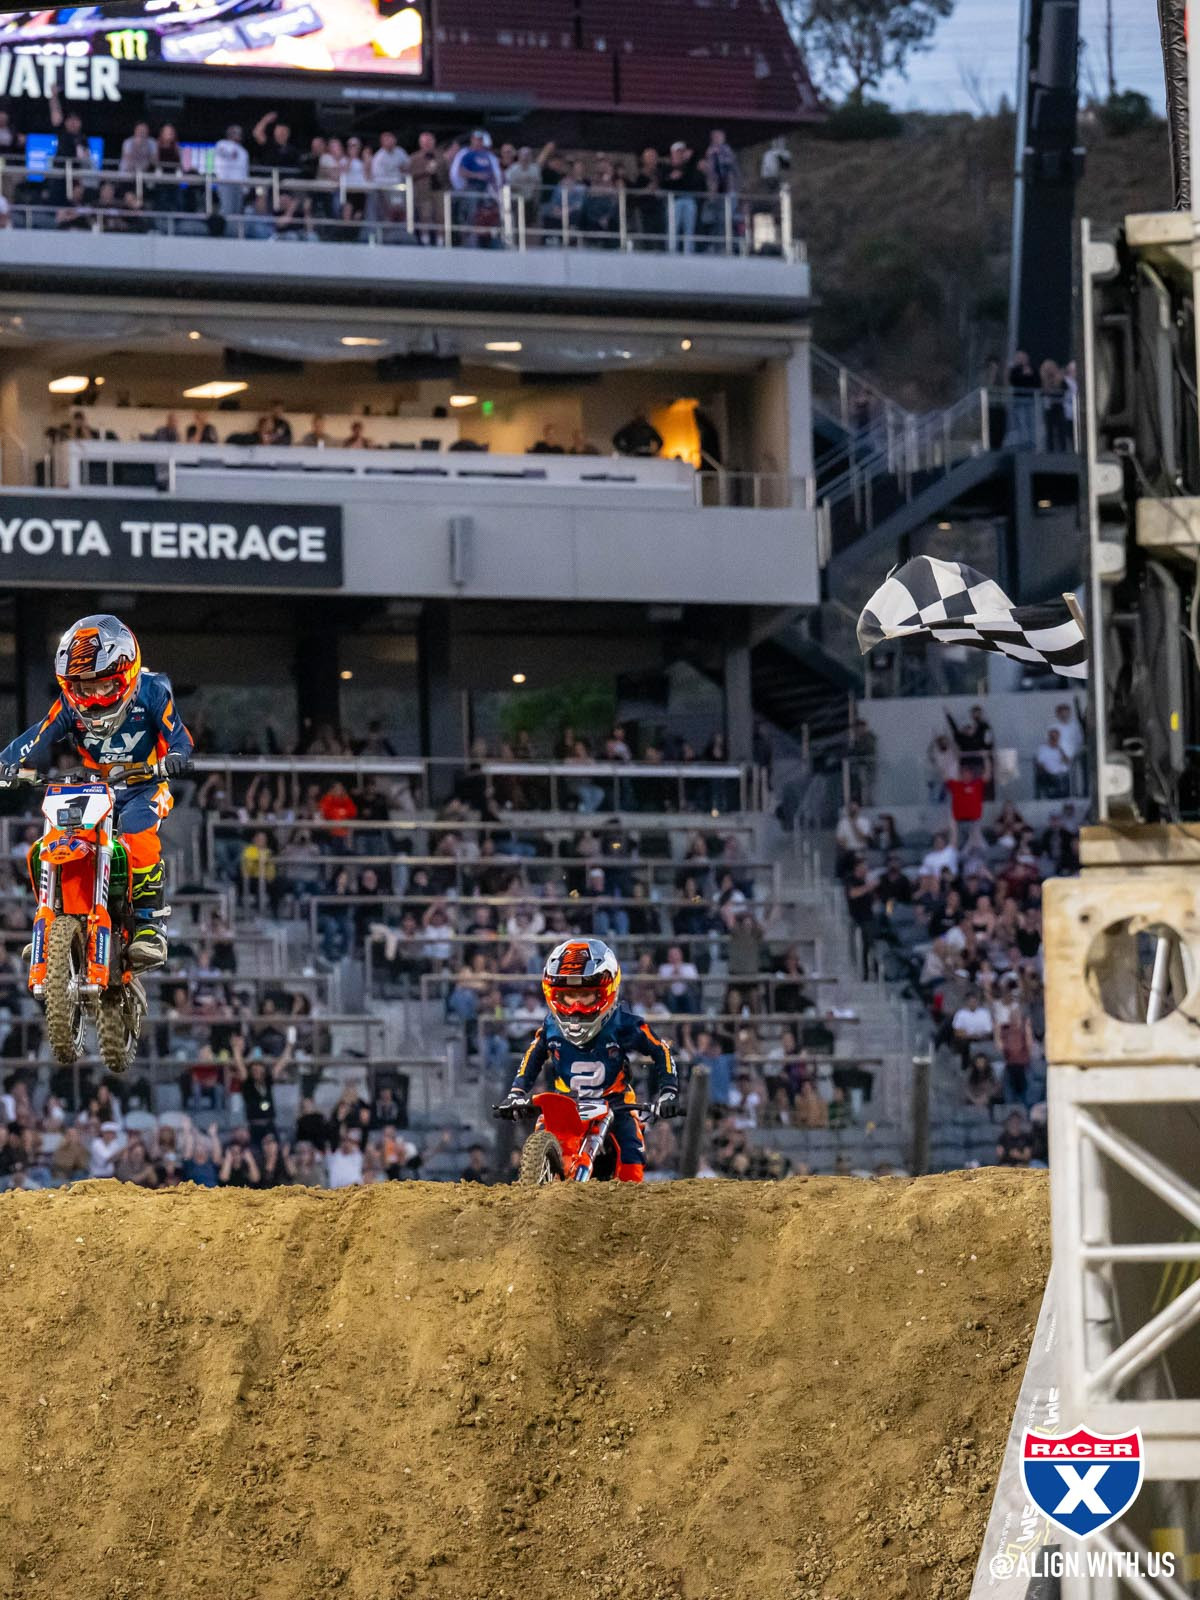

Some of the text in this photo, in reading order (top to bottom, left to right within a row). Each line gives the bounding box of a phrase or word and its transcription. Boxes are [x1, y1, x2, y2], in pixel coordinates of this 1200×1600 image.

[121, 520, 327, 563] TERRACE
[64, 795, 91, 823] 1
[570, 1061, 605, 1098] 2
